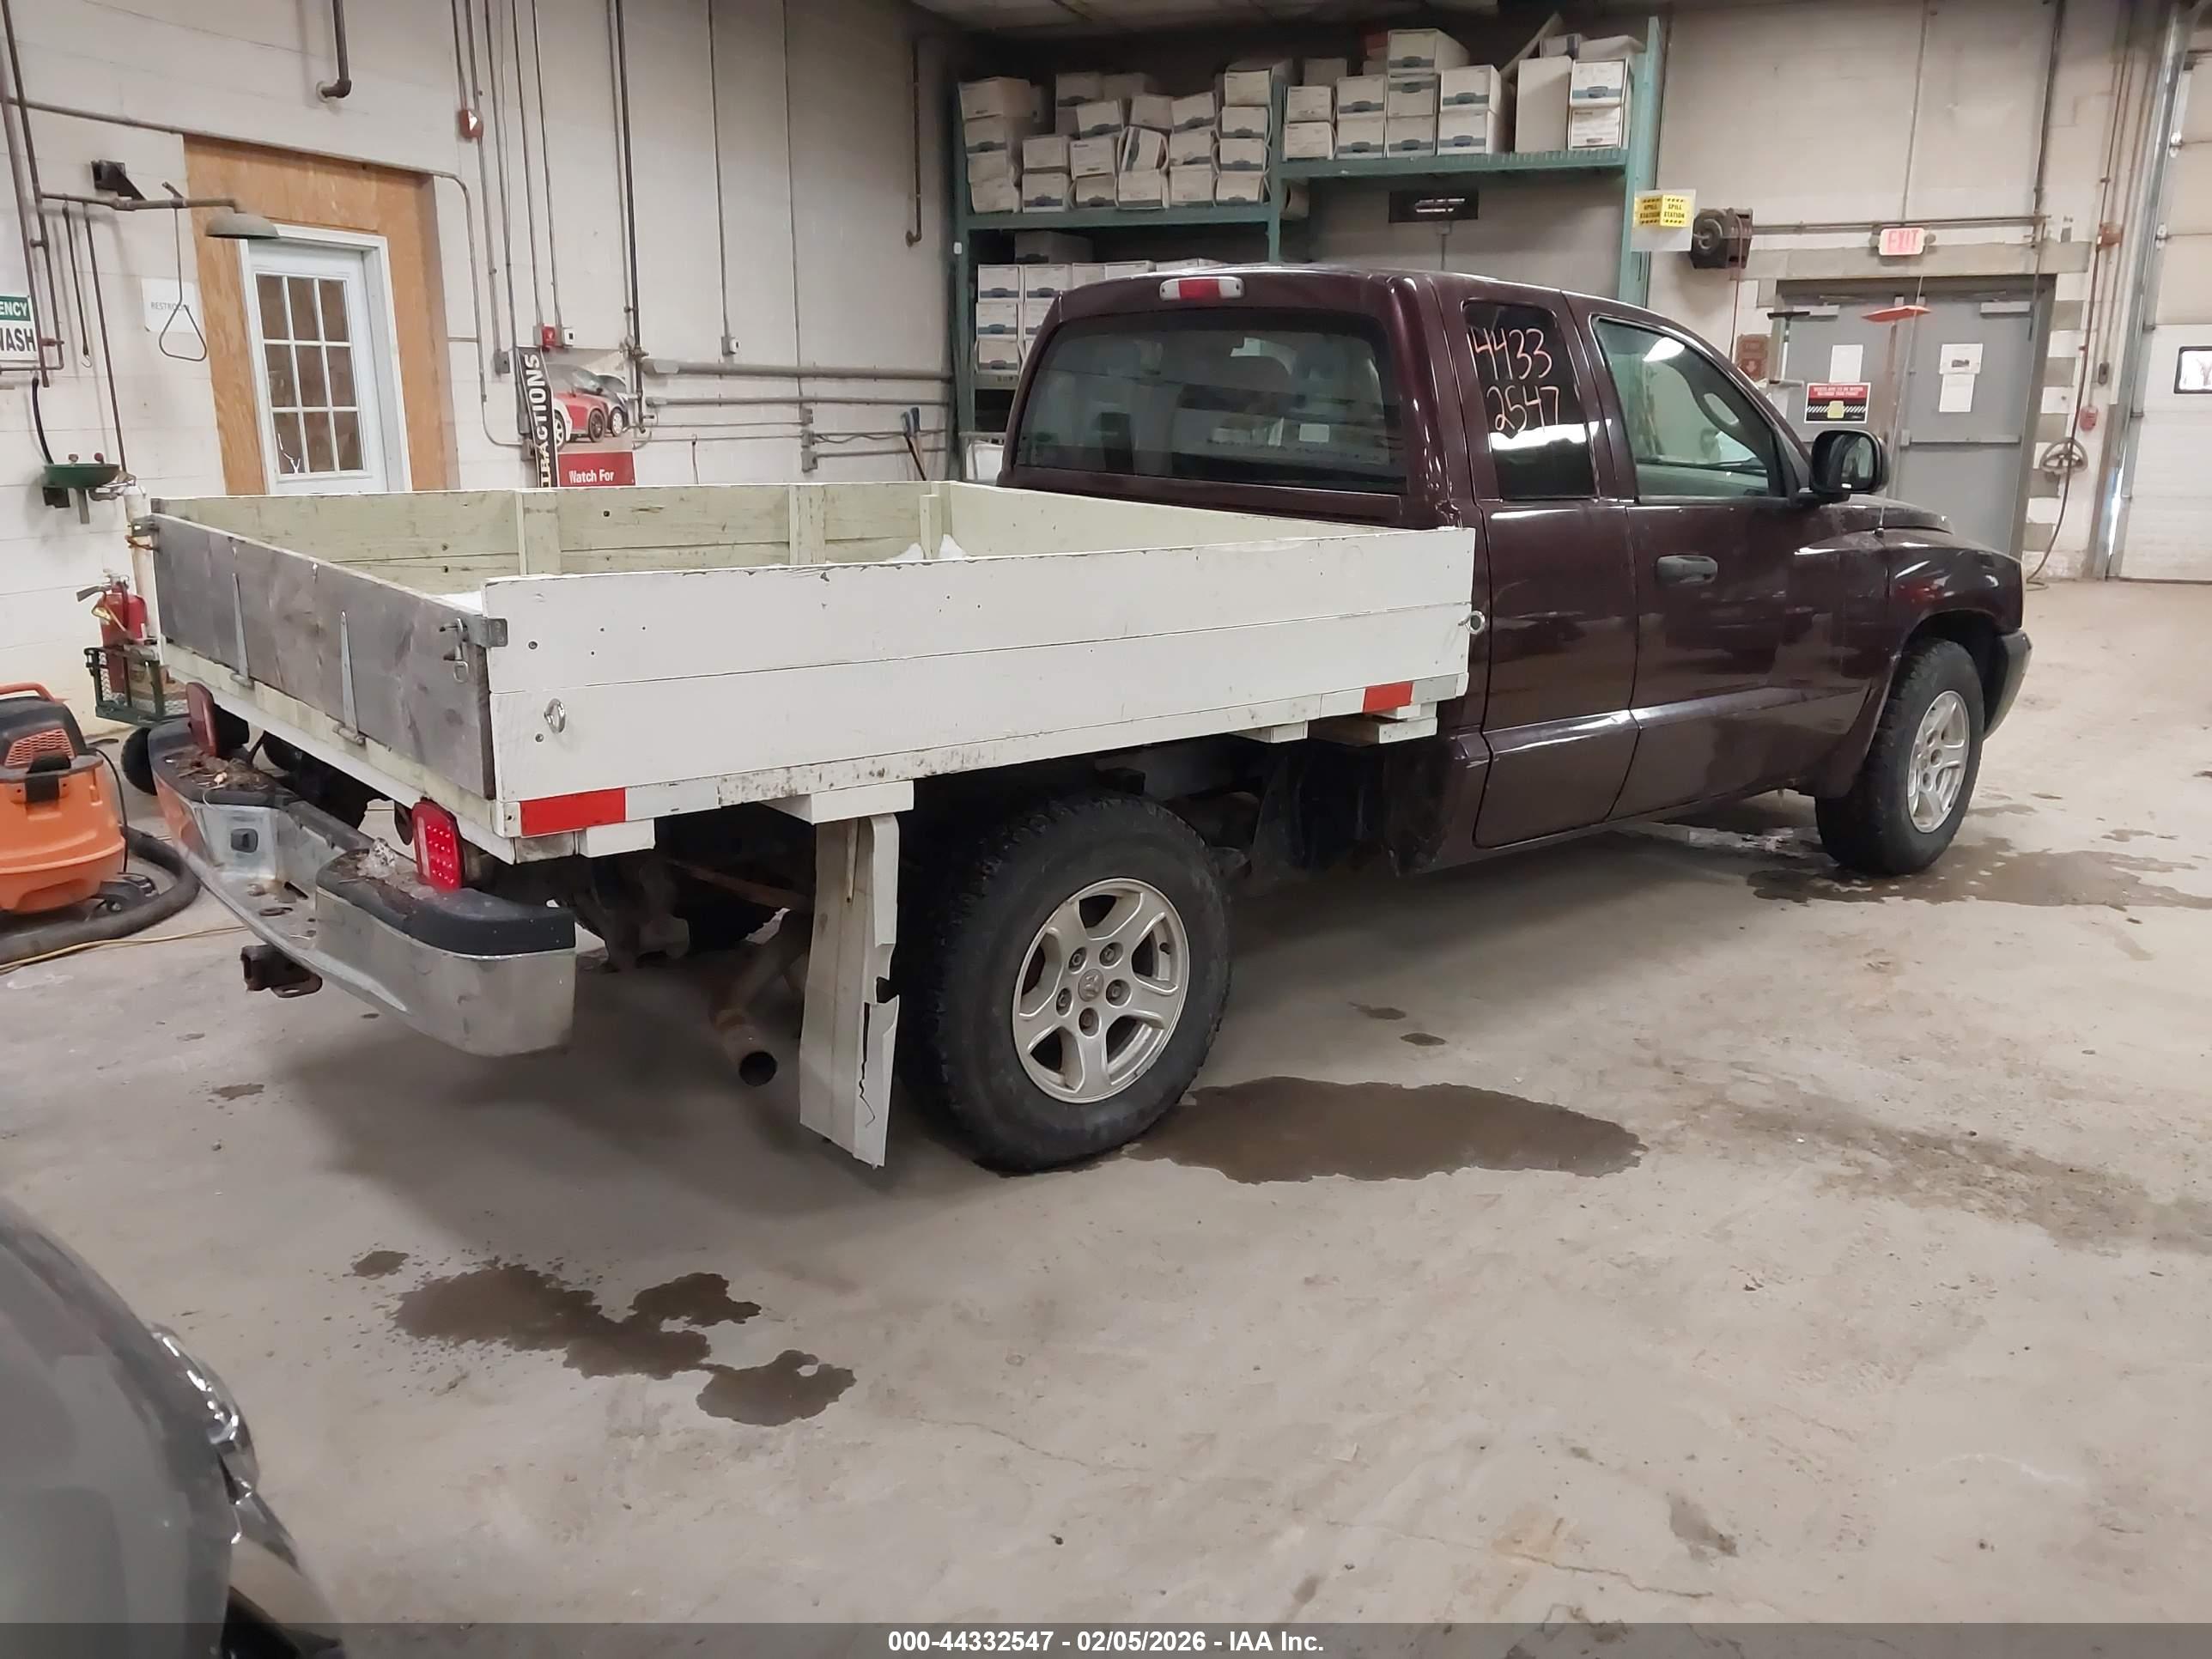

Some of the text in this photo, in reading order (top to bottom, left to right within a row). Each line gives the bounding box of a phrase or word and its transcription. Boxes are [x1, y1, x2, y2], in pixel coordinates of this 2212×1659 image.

[1887, 229, 1919, 251] EXIT
[1471, 327, 1553, 380] 4433
[1486, 385, 1559, 433] 2547
[568, 468, 615, 484] Watch For
